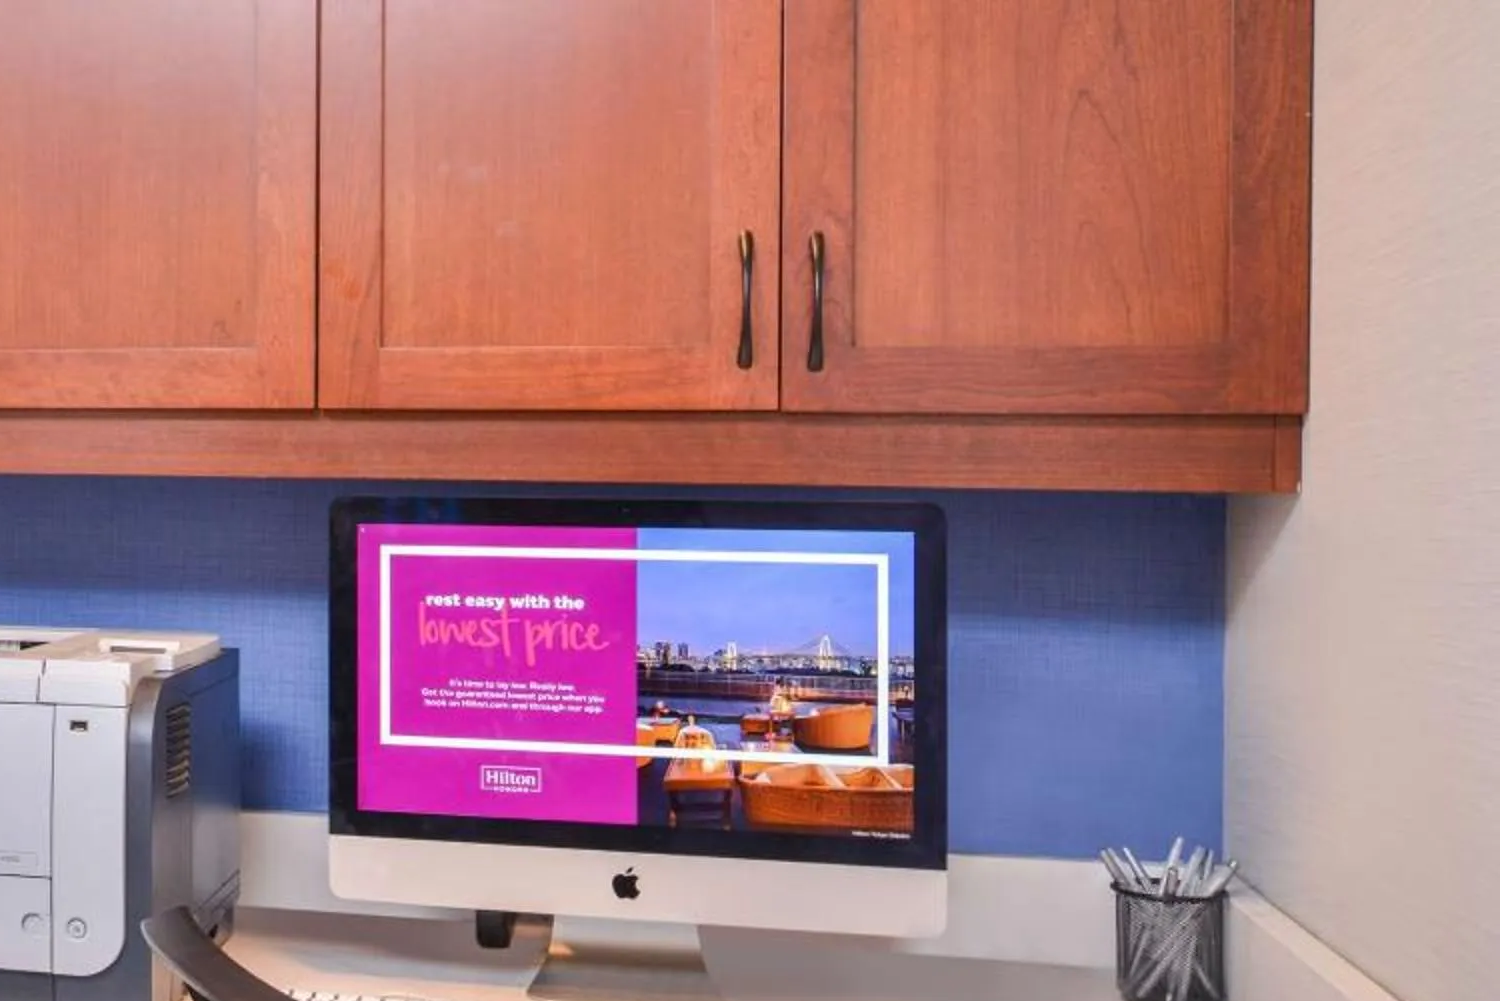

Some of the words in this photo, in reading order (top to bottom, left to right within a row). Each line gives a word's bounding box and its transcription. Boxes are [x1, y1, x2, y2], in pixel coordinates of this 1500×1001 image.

[425, 594, 461, 607] rest
[464, 595, 505, 611] easy
[509, 594, 550, 609] with
[554, 595, 585, 610] the
[418, 602, 520, 657] lowest
[524, 613, 610, 667] price
[486, 770, 536, 786] Hilton
